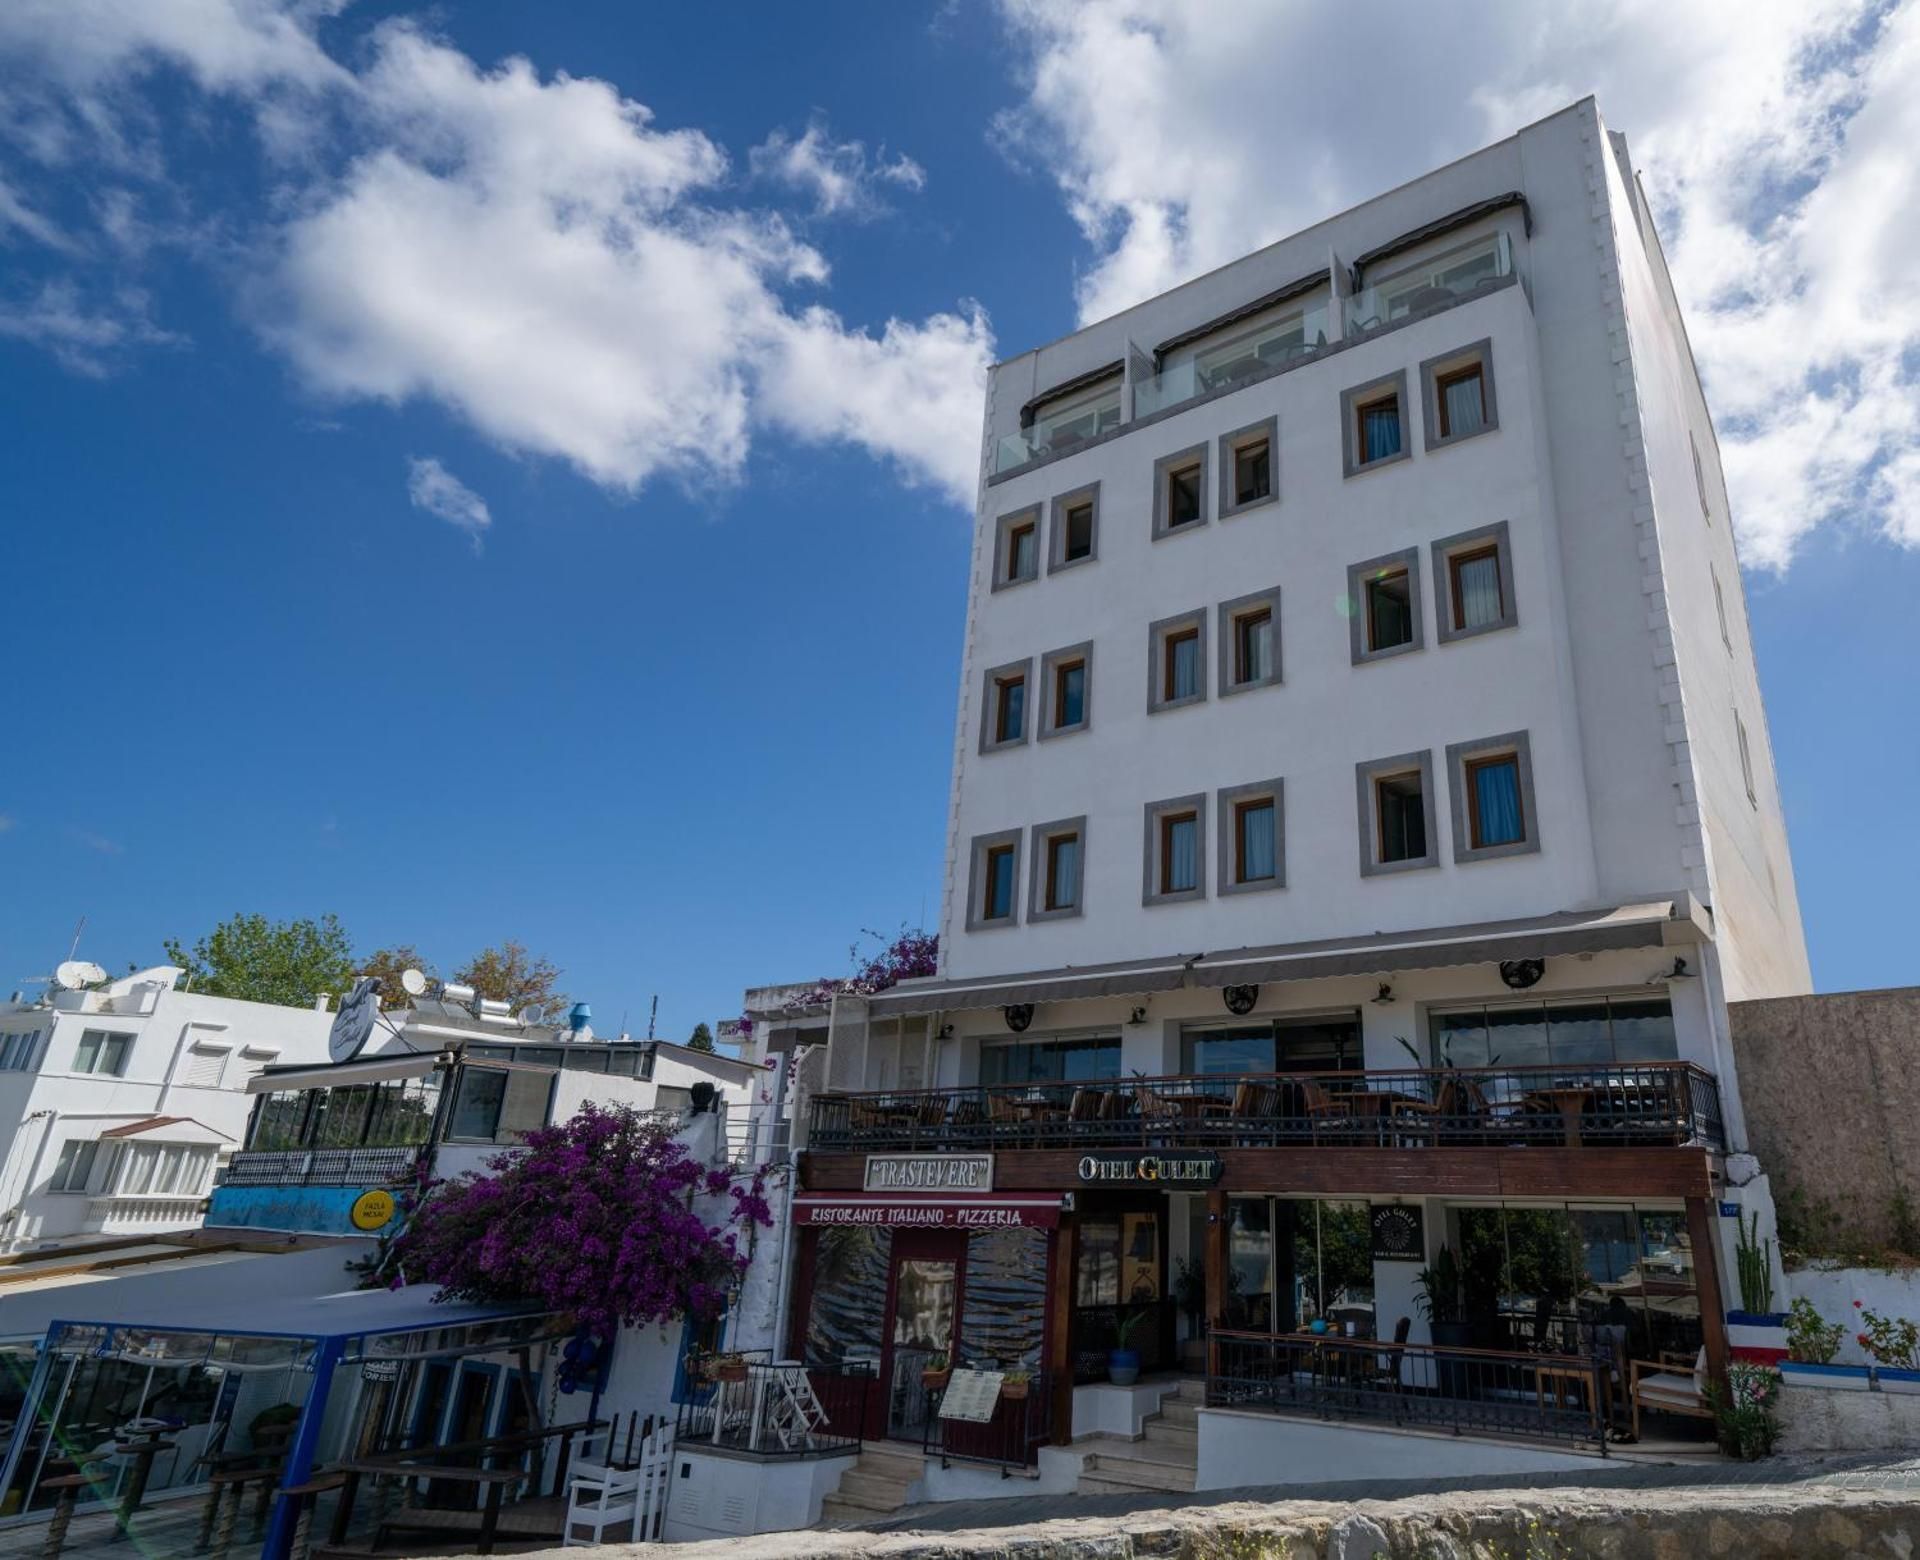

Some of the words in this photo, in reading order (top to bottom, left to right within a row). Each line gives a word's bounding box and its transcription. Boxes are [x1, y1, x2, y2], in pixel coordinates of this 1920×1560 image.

[1078, 1156, 1135, 1180] OTEL
[1138, 1156, 1215, 1181] GULET
[811, 1207, 884, 1222] RISTORANTE
[887, 1208, 944, 1223] ITALIANO
[957, 1209, 1022, 1225] PIZZERIA
[1374, 1209, 1391, 1227] OTEL
[1393, 1208, 1417, 1227] GULET
